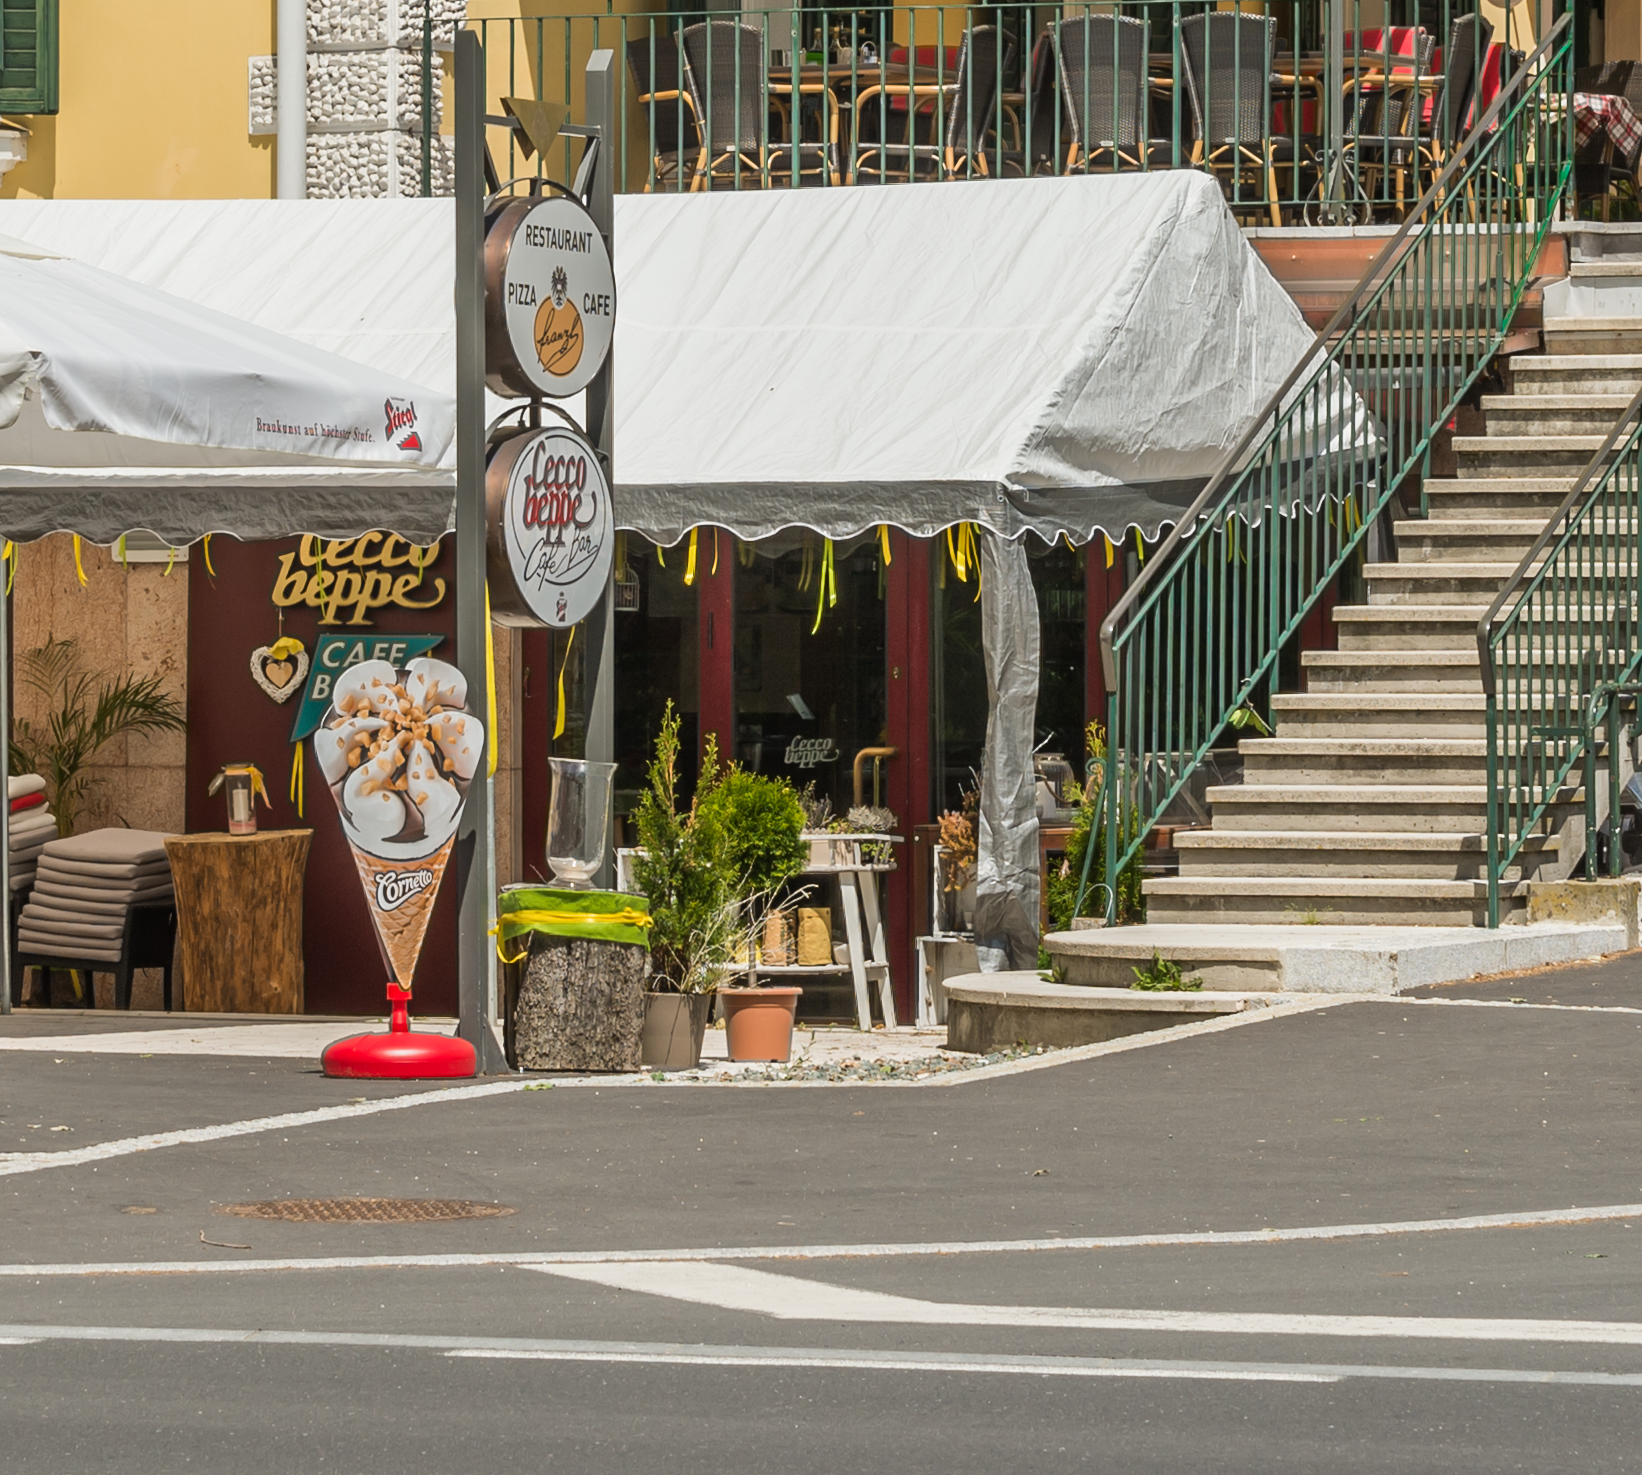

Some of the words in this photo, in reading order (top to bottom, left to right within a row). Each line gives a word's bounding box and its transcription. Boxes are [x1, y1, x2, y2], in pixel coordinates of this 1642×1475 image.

[525, 224, 593, 254] RESTAURANT
[508, 282, 537, 307] PIZZA
[583, 292, 611, 317] CAFE
[256, 416, 302, 435] Braukunst
[304, 422, 318, 437] auf
[271, 551, 446, 625] beppe
[321, 642, 407, 669] CAFE
[374, 869, 434, 913] Cornetto
